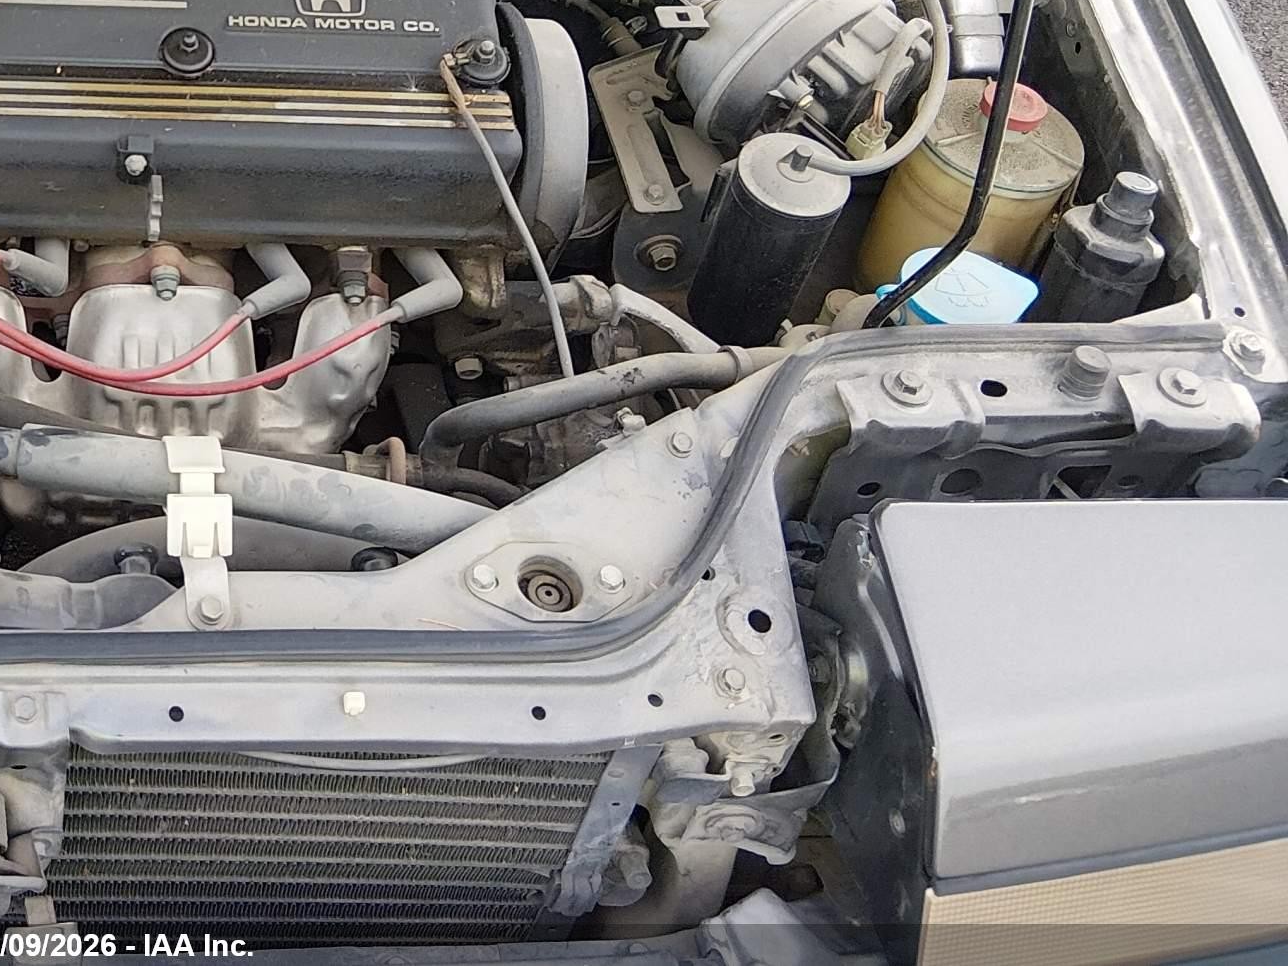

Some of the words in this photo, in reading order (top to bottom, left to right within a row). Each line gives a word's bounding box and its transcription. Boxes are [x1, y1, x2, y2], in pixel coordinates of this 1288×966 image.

[228, 15, 307, 28] HONDA
[314, 18, 396, 31] MOTOR
[402, 20, 440, 32] CO.
